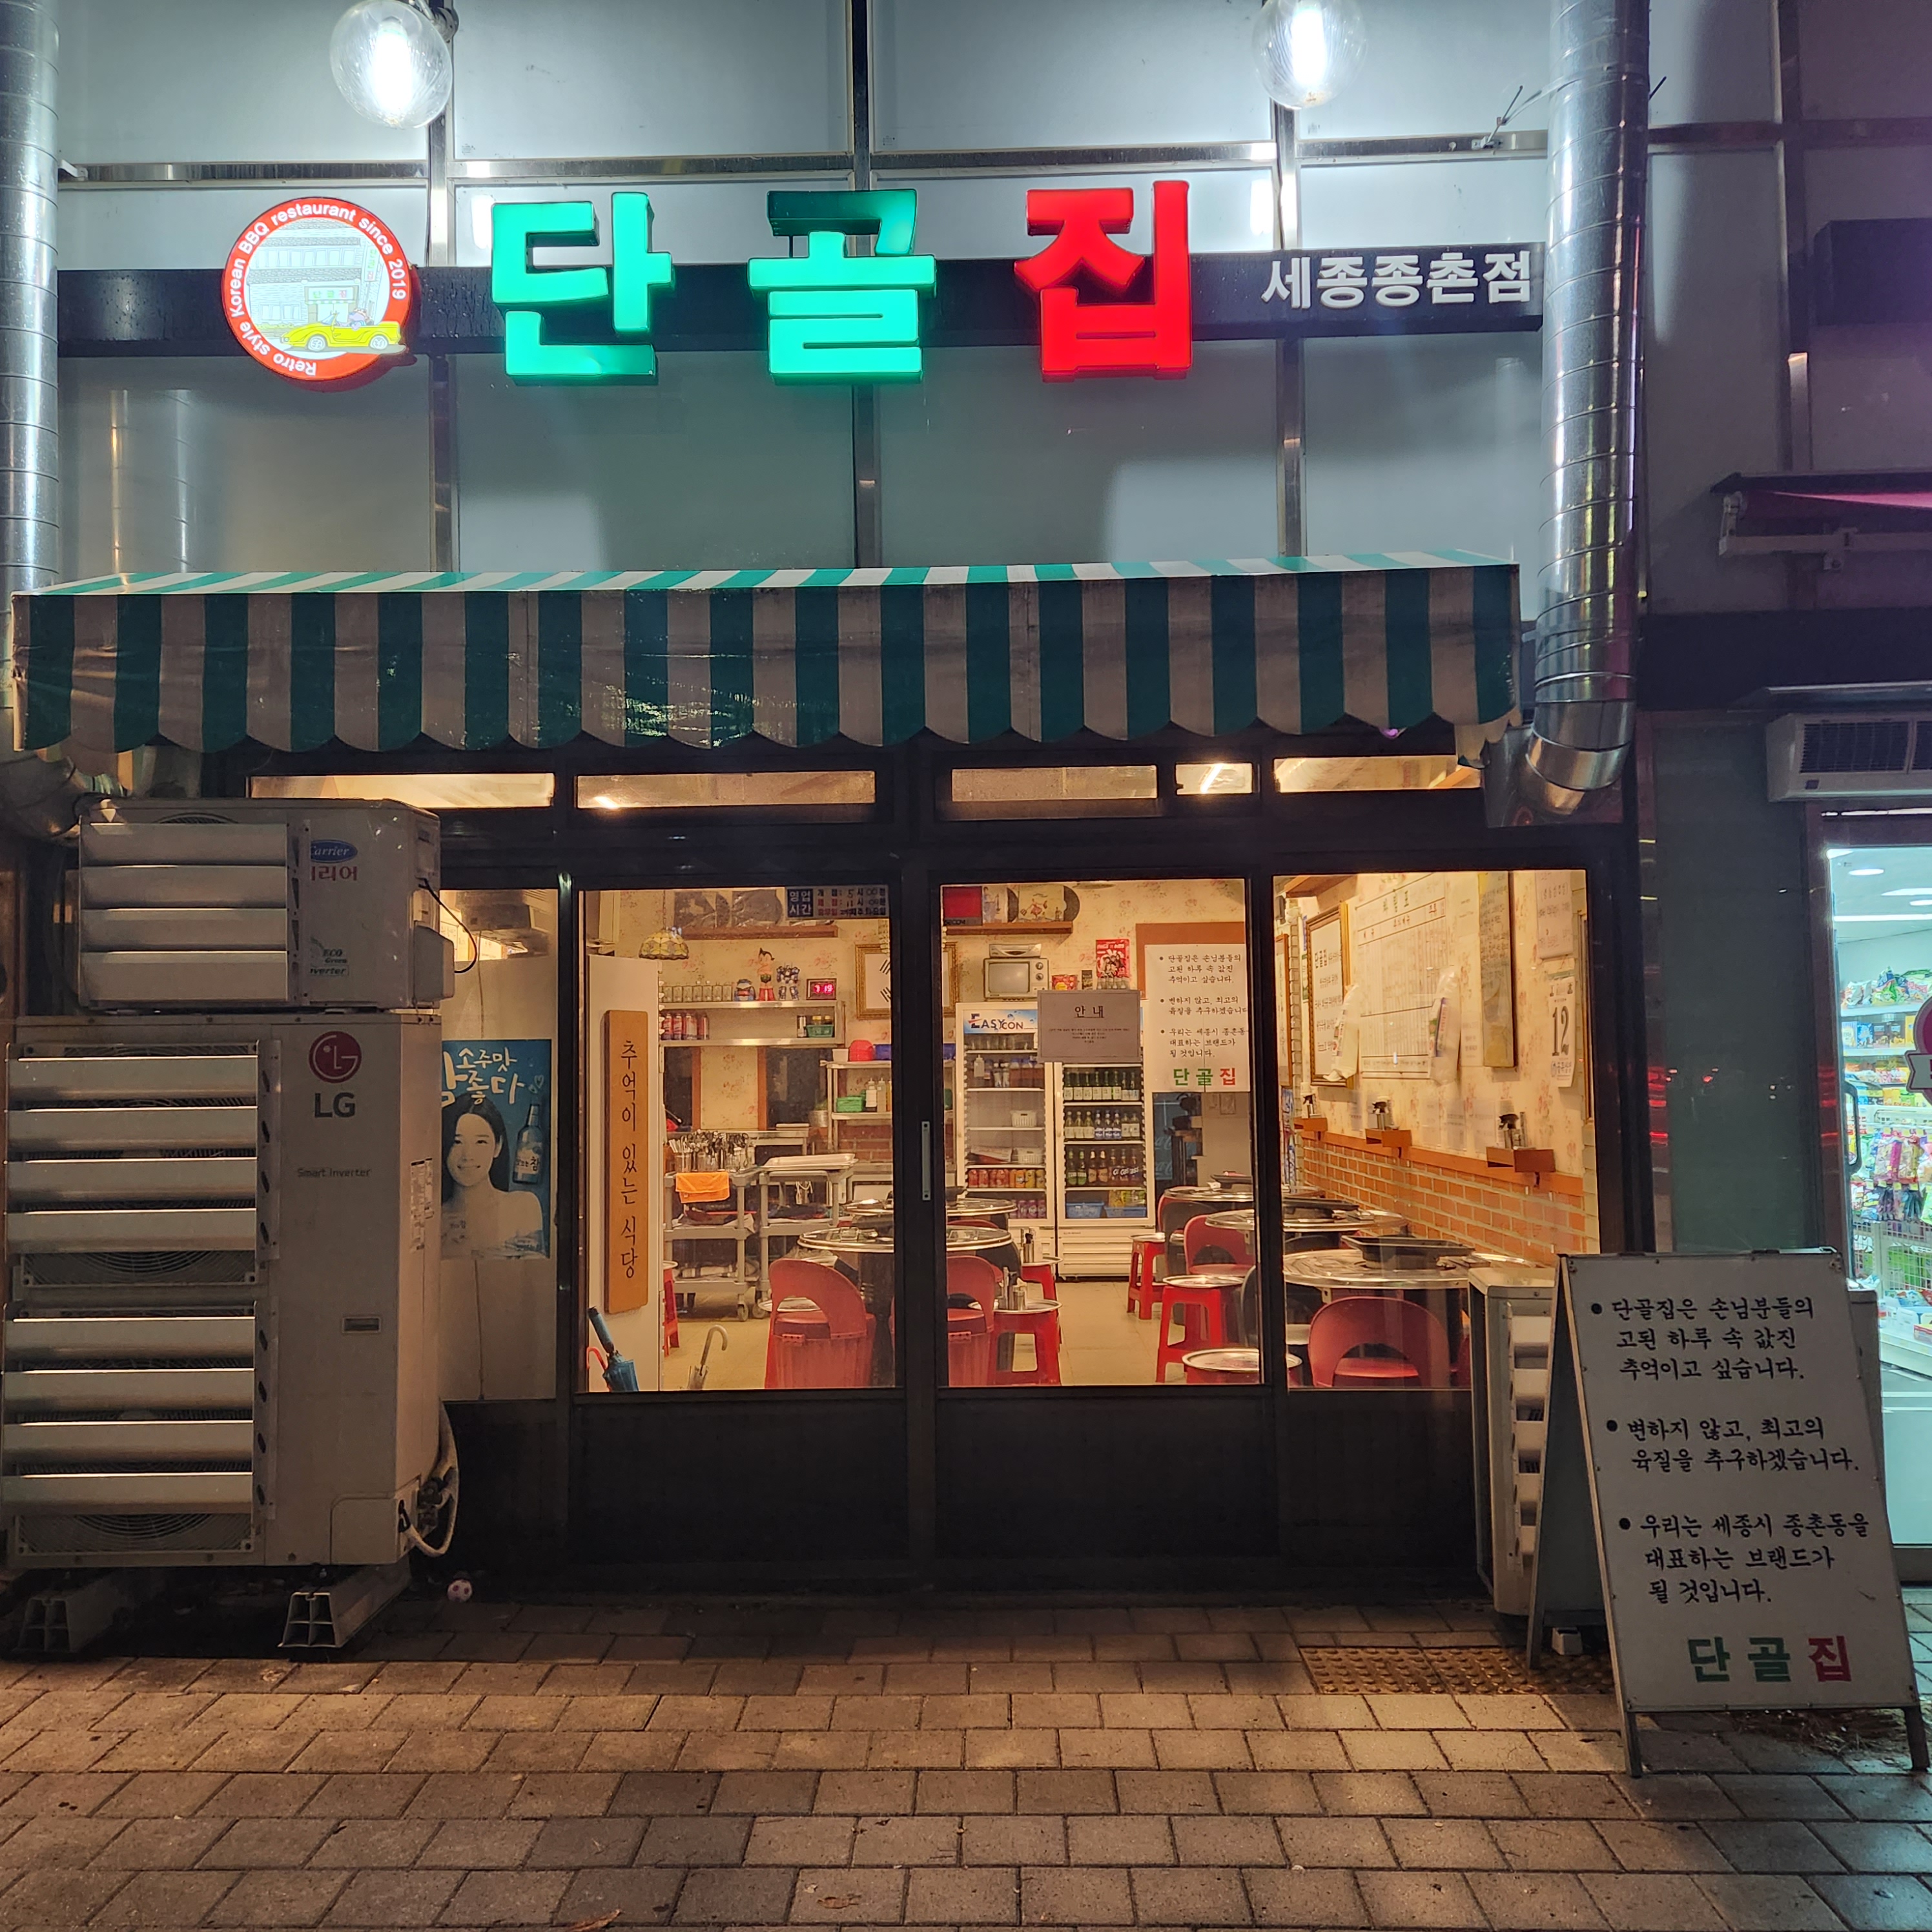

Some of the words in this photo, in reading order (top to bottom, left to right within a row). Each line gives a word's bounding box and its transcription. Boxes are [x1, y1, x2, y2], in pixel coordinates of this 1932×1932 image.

[271, 203, 356, 225] restaurant
[239, 222, 270, 254] BBQ
[359, 218, 393, 254] since
[229, 258, 246, 318] Korean
[389, 259, 406, 300] 2019
[491, 180, 1192, 382] 단골집
[1261, 251, 1530, 309] 세종종촌점
[240, 322, 270, 356] style
[273, 354, 316, 376] Retro
[311, 845, 349, 856] arrier
[789, 890, 811, 902] 영업
[789, 904, 812, 916] 시간
[1187, 965, 1202, 973] 하루
[1206, 965, 1214, 973] 속
[1218, 964, 1233, 973] 값진
[1202, 954, 1241, 962] 손님분들의
[1201, 975, 1235, 983] 싶습니다.
[1169, 996, 1191, 1005] 변하지
[1197, 1028, 1218, 1036] 세종시
[1222, 1027, 1249, 1036] 종촌동
[1204, 1038, 1236, 1047] 브랜드가
[1552, 1005, 1570, 1056] 12
[456, 1047, 517, 1072] 소주맛
[1180, 1049, 1215, 1058] 것입니다.
[466, 1070, 525, 1105] 좋다
[621, 1040, 638, 1132] 추억이
[1173, 1067, 1236, 1086] 단골집
[314, 1092, 355, 1118] LG
[298, 1168, 325, 1177] Smart
[330, 1168, 370, 1177] Inverter
[621, 1144, 638, 1204] 있는
[621, 1215, 638, 1279] 식당
[1612, 1299, 1698, 1321] 단골집은
[1709, 1297, 1814, 1319] 손님분들의
[1616, 1328, 1656, 1350] 고된
[1669, 1328, 1712, 1350] 하루
[1723, 1328, 1743, 1350] 속
[1754, 1327, 1796, 1350] 값진
[1619, 1358, 1702, 1381] 추억이고
[1712, 1357, 1804, 1381] 싶습니다.
[1627, 1419, 1689, 1441] 변하지
[1700, 1418, 1751, 1442] 않고,
[1761, 1417, 1824, 1440] 최고의
[1632, 1450, 1693, 1472] 육질을
[1704, 1448, 1860, 1472] 추구하겠습니다.
[1641, 1515, 1702, 1538] 우리는
[1712, 1514, 1773, 1537] 세종시
[1783, 1513, 1869, 1537] 종촌동을
[1645, 1548, 1733, 1570] 대표하는
[1745, 1547, 1835, 1570] 브랜드가
[1649, 1580, 1669, 1604] 될
[1679, 1578, 1772, 1604] 것입니다.
[1687, 1636, 1852, 1683] 단골집
